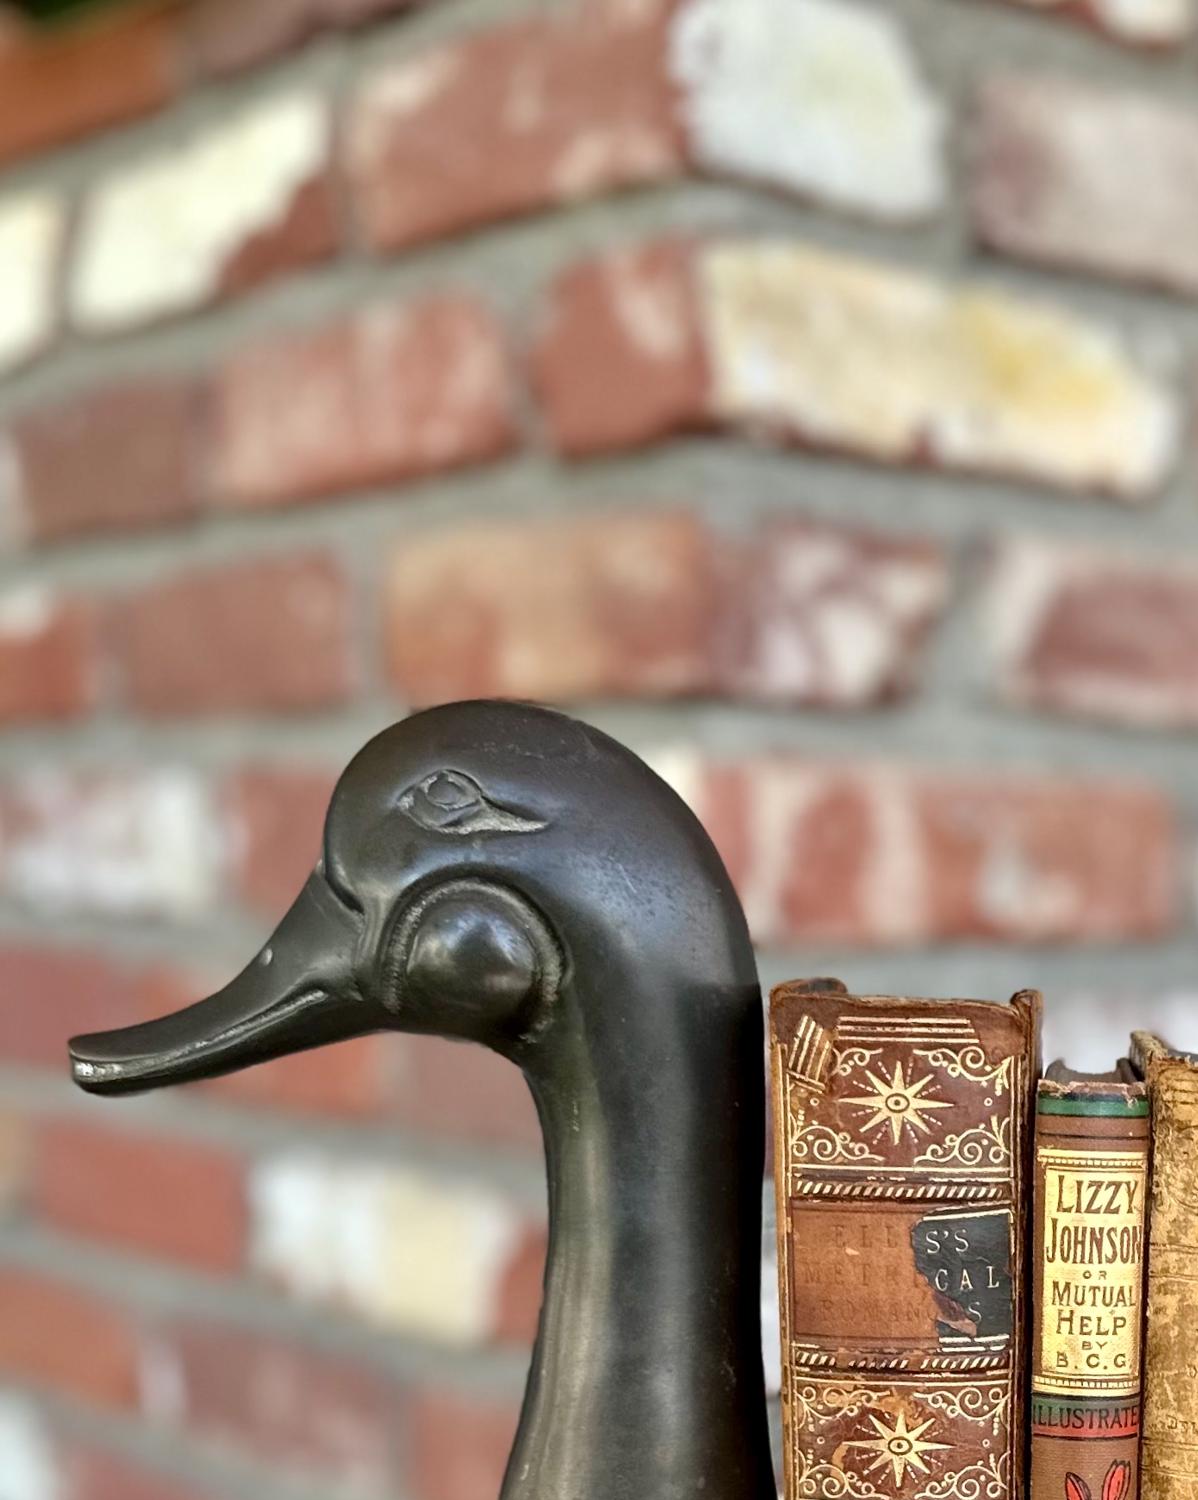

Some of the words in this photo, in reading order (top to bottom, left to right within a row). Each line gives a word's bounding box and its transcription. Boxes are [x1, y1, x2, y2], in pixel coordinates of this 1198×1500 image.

[1046, 1217, 1142, 1264] JOHNSON
[1082, 1270, 1107, 1280] OR
[1051, 1280, 1137, 1307] MUTUAL
[1055, 1308, 1127, 1336] HELP
[1081, 1340, 1109, 1351] BY
[1032, 1403, 1140, 1430] ILLUSTRATE
